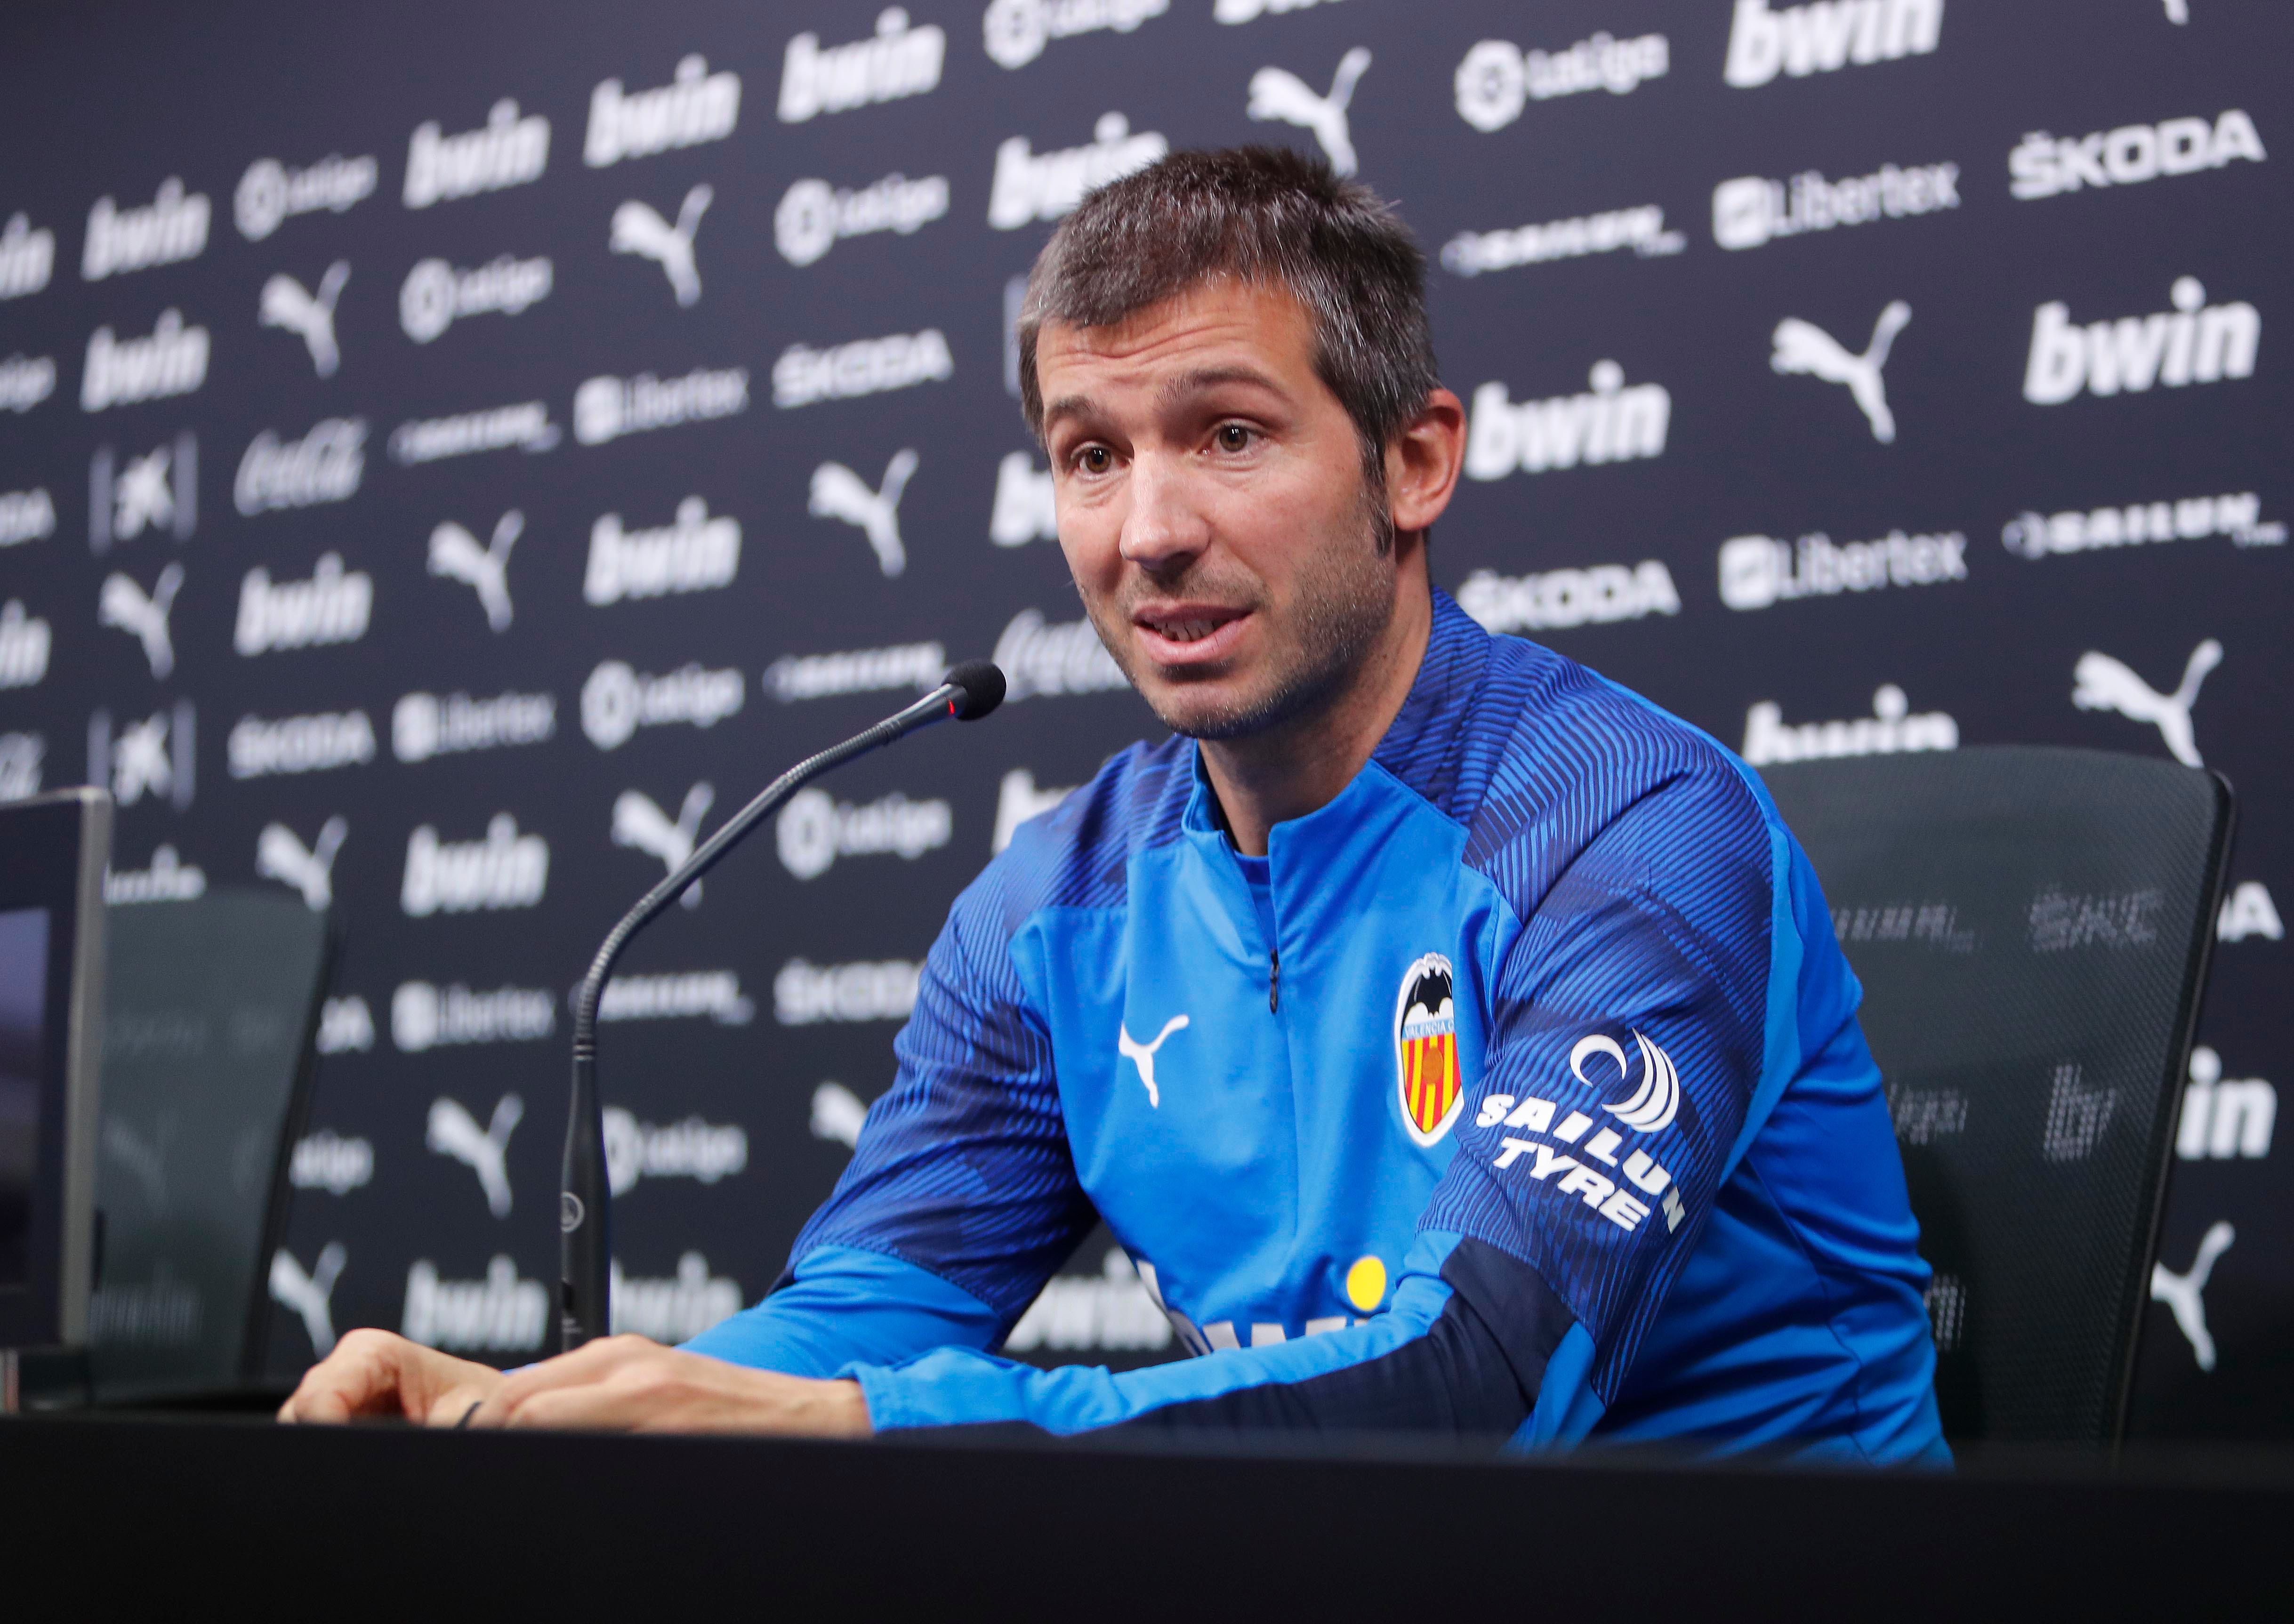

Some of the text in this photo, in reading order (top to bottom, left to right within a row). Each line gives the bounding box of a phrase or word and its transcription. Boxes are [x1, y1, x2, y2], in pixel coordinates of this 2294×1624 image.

[584, 55, 741, 167] bwin
[778, 8, 945, 122] bwin
[1526, 32, 1670, 99] LaLiga
[403, 100, 550, 208] bwin
[1773, 162, 1960, 237] Libertex
[2008, 109, 2265, 200] ŠKODA
[82, 179, 211, 280] bwin
[81, 311, 210, 411] bwin
[2023, 277, 2260, 404] bwin
[1465, 360, 1671, 480] bwin
[585, 497, 741, 605] bwin
[1779, 530, 1967, 599] Libertex
[235, 554, 372, 655] bwin
[402, 815, 548, 916] bwin
[774, 959, 926, 1024] ŠKOD
[1476, 1093, 1686, 1234] SAILUN
[1493, 1137, 1650, 1232] TYRE
[402, 1255, 548, 1351] bwin
